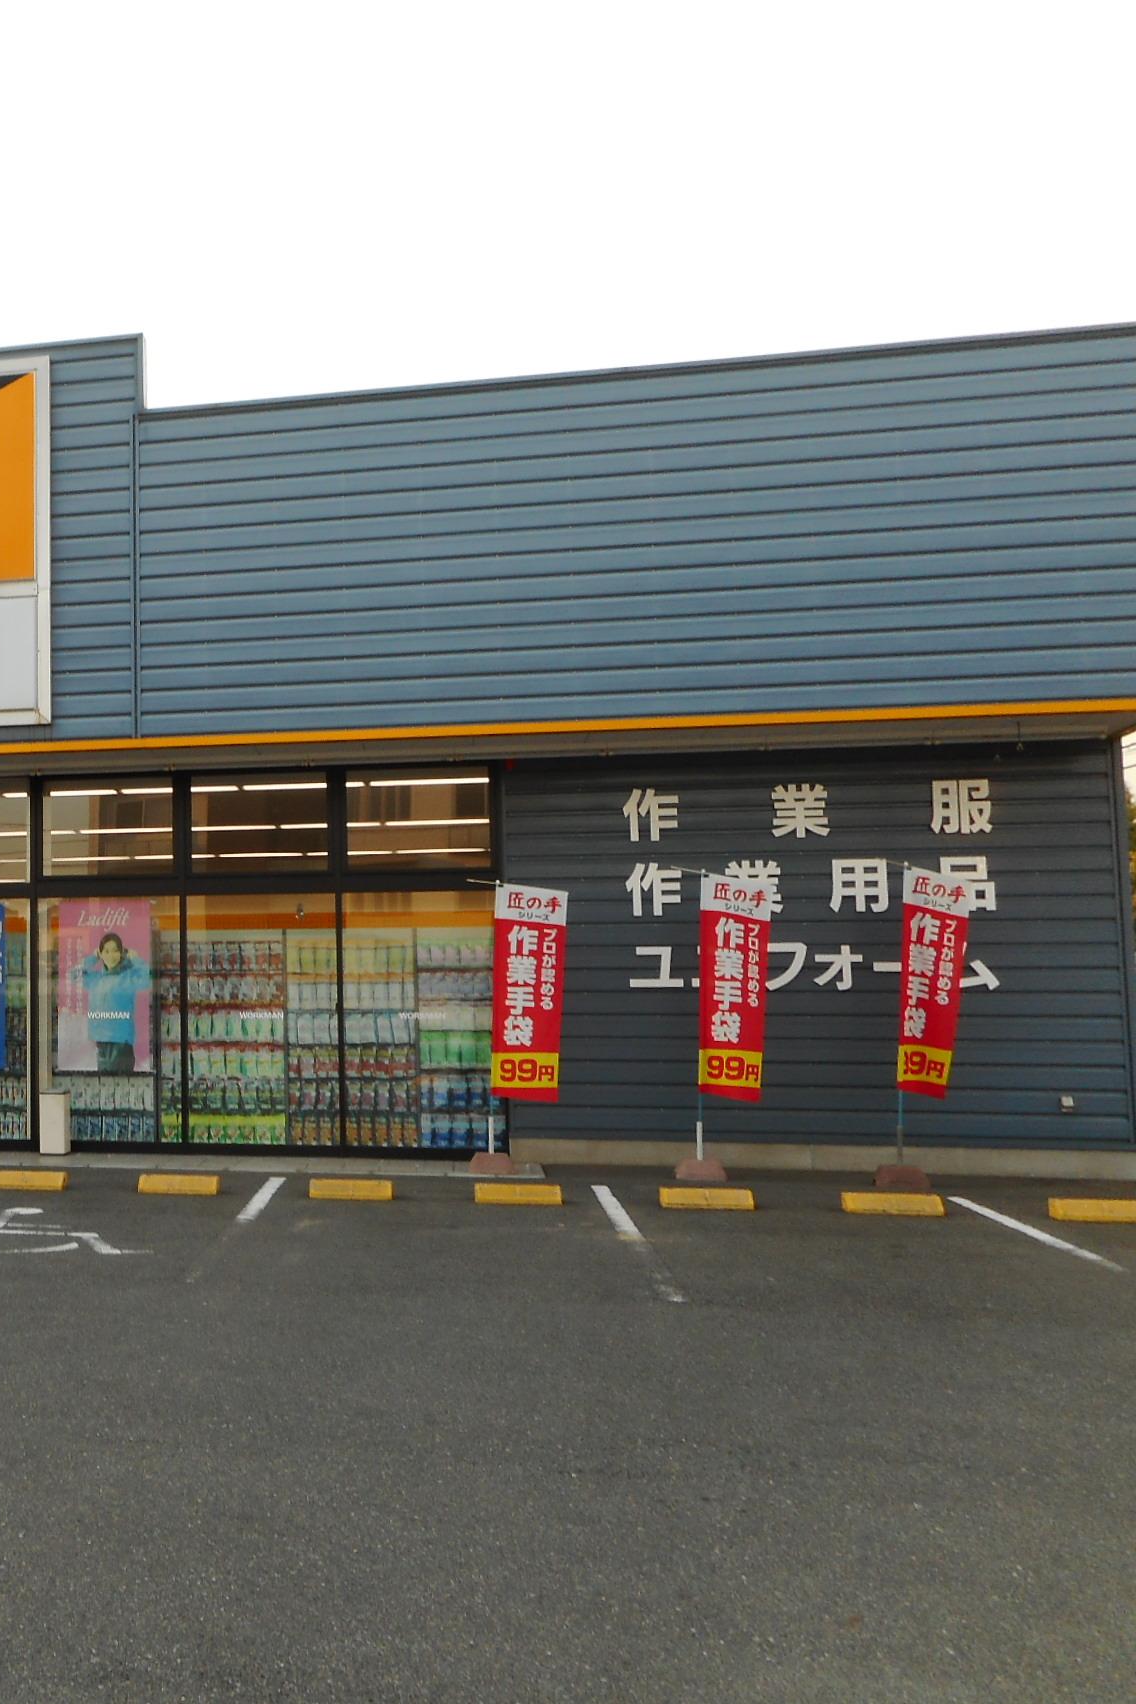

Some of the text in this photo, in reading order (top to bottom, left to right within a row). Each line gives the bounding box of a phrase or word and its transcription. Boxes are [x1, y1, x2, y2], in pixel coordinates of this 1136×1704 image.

[622, 778, 993, 842] 作業服
[507, 891, 562, 914] 匠の手
[713, 883, 767, 909] 匠の手
[912, 876, 966, 904] 匠の手
[518, 911, 551, 922] シリーズ
[725, 902, 754, 916] シリーズ
[923, 897, 952, 911] シリーズ
[78, 907, 130, 932] Ladifit
[503, 925, 539, 1047] 作業手袋
[711, 917, 745, 1043] 作業手袋
[904, 911, 940, 1039] 作業手袋
[87, 1011, 130, 1020] WORKMAN
[239, 1011, 284, 1020] WORKMAN
[499, 1058, 555, 1083] 99円
[706, 1055, 759, 1082] 99円
